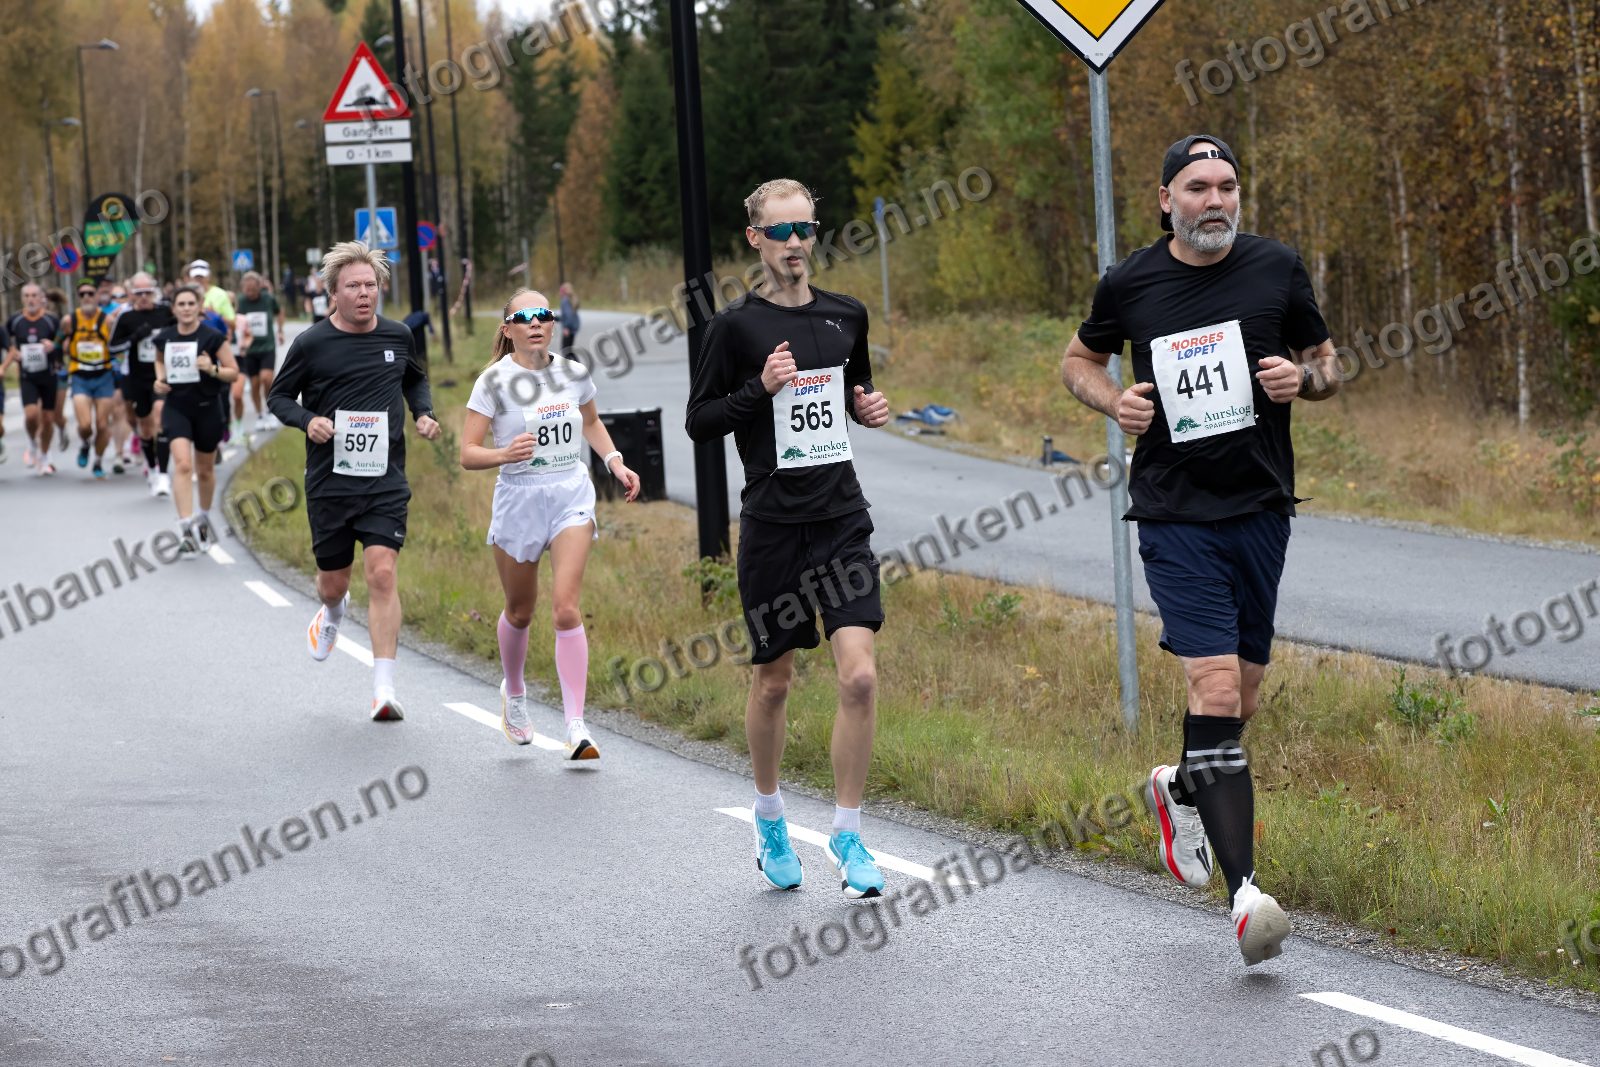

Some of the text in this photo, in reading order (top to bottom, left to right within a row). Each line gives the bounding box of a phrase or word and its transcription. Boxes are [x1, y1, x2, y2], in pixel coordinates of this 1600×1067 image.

[342, 126, 393, 138] Gangfelt
[346, 149, 355, 160] 0
[1171, 331, 1224, 351] NORGES
[1177, 343, 1218, 360] LØPET
[791, 374, 832, 387] NORGES
[1176, 361, 1229, 399] 441
[795, 384, 826, 396] LØPET
[537, 403, 570, 414] NORGES
[541, 410, 567, 420] LØPET
[1203, 404, 1252, 422] Aurskog
[791, 400, 833, 432] 565
[1204, 418, 1246, 431] SPAREBANK
[538, 422, 572, 446] 810
[344, 433, 379, 452] 597
[809, 440, 848, 454] Aurskog
[355, 460, 385, 469] Aurskog
